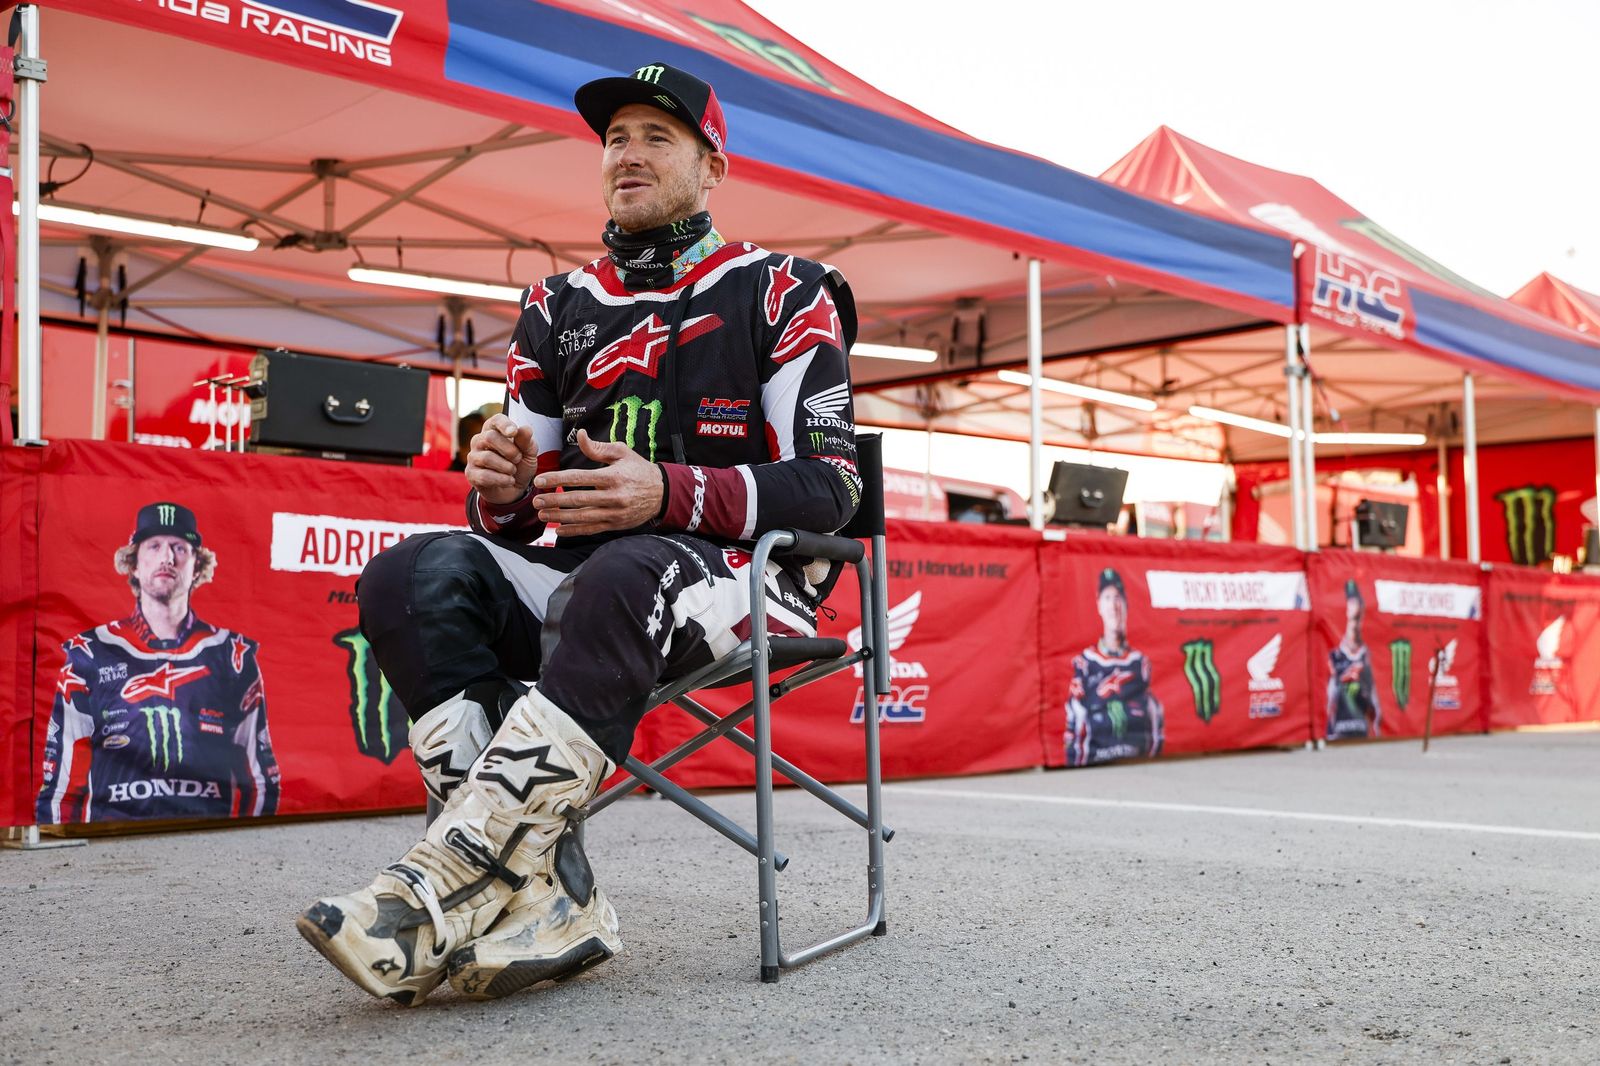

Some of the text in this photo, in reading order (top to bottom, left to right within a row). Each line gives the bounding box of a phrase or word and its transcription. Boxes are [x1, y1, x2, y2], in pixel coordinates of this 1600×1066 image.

[240, 7, 393, 67] RACING
[625, 260, 664, 269] HONDA
[1312, 247, 1404, 328] HRC
[189, 398, 252, 429] MOT
[697, 397, 750, 416] HRC
[699, 423, 745, 436] MOTUL
[806, 417, 856, 433] HONDA
[300, 526, 405, 566] ADRIE
[108, 778, 223, 803] HONDA
